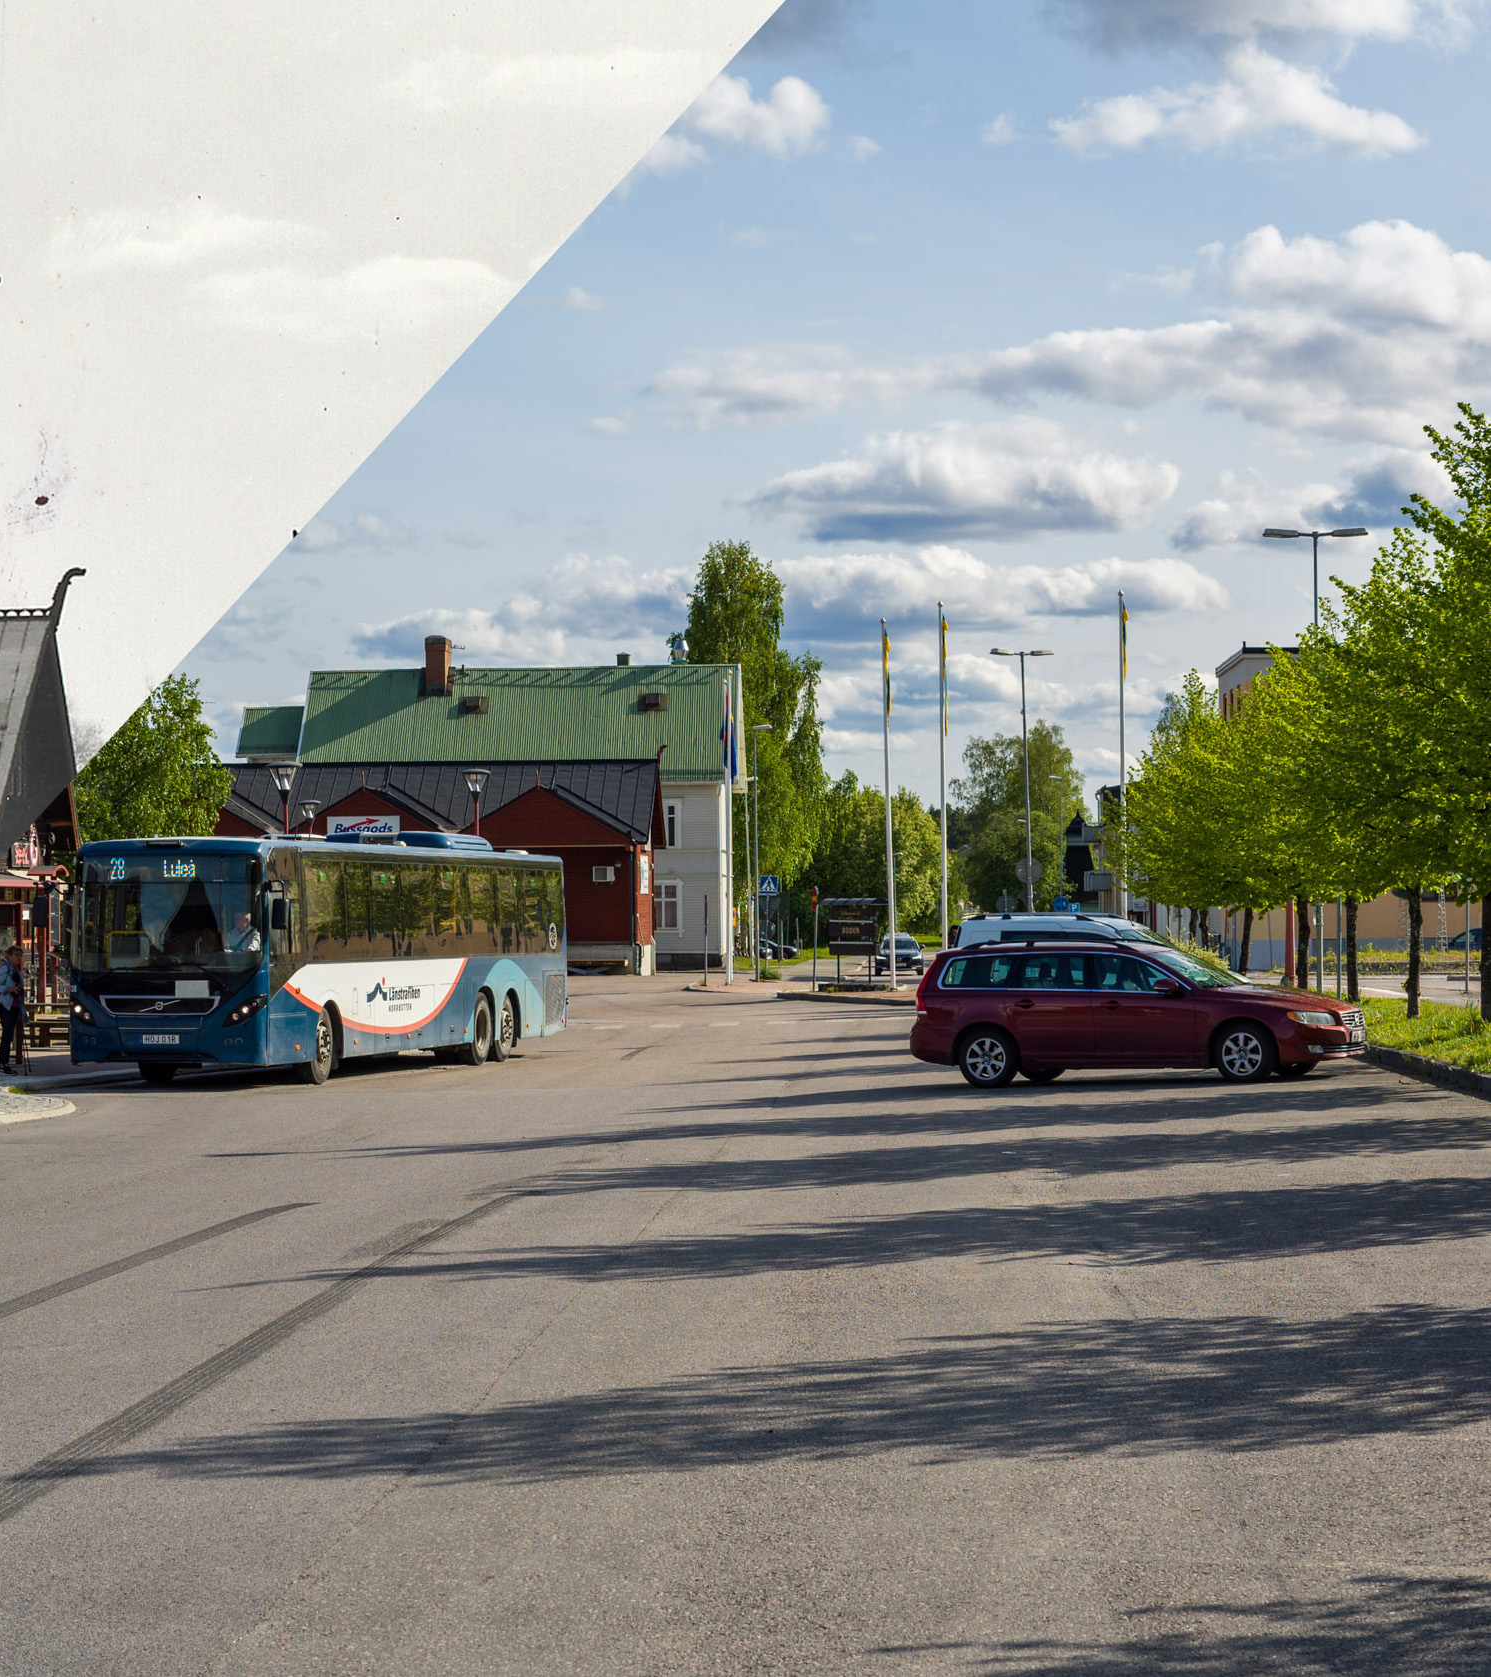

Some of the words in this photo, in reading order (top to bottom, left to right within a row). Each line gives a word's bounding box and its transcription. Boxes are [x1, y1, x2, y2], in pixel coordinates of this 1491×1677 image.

[110, 858, 125, 879] 28
[163, 859, 196, 877] Luleå
[841, 926, 860, 935] BODEN
[388, 985, 421, 1001] Länstrafiken
